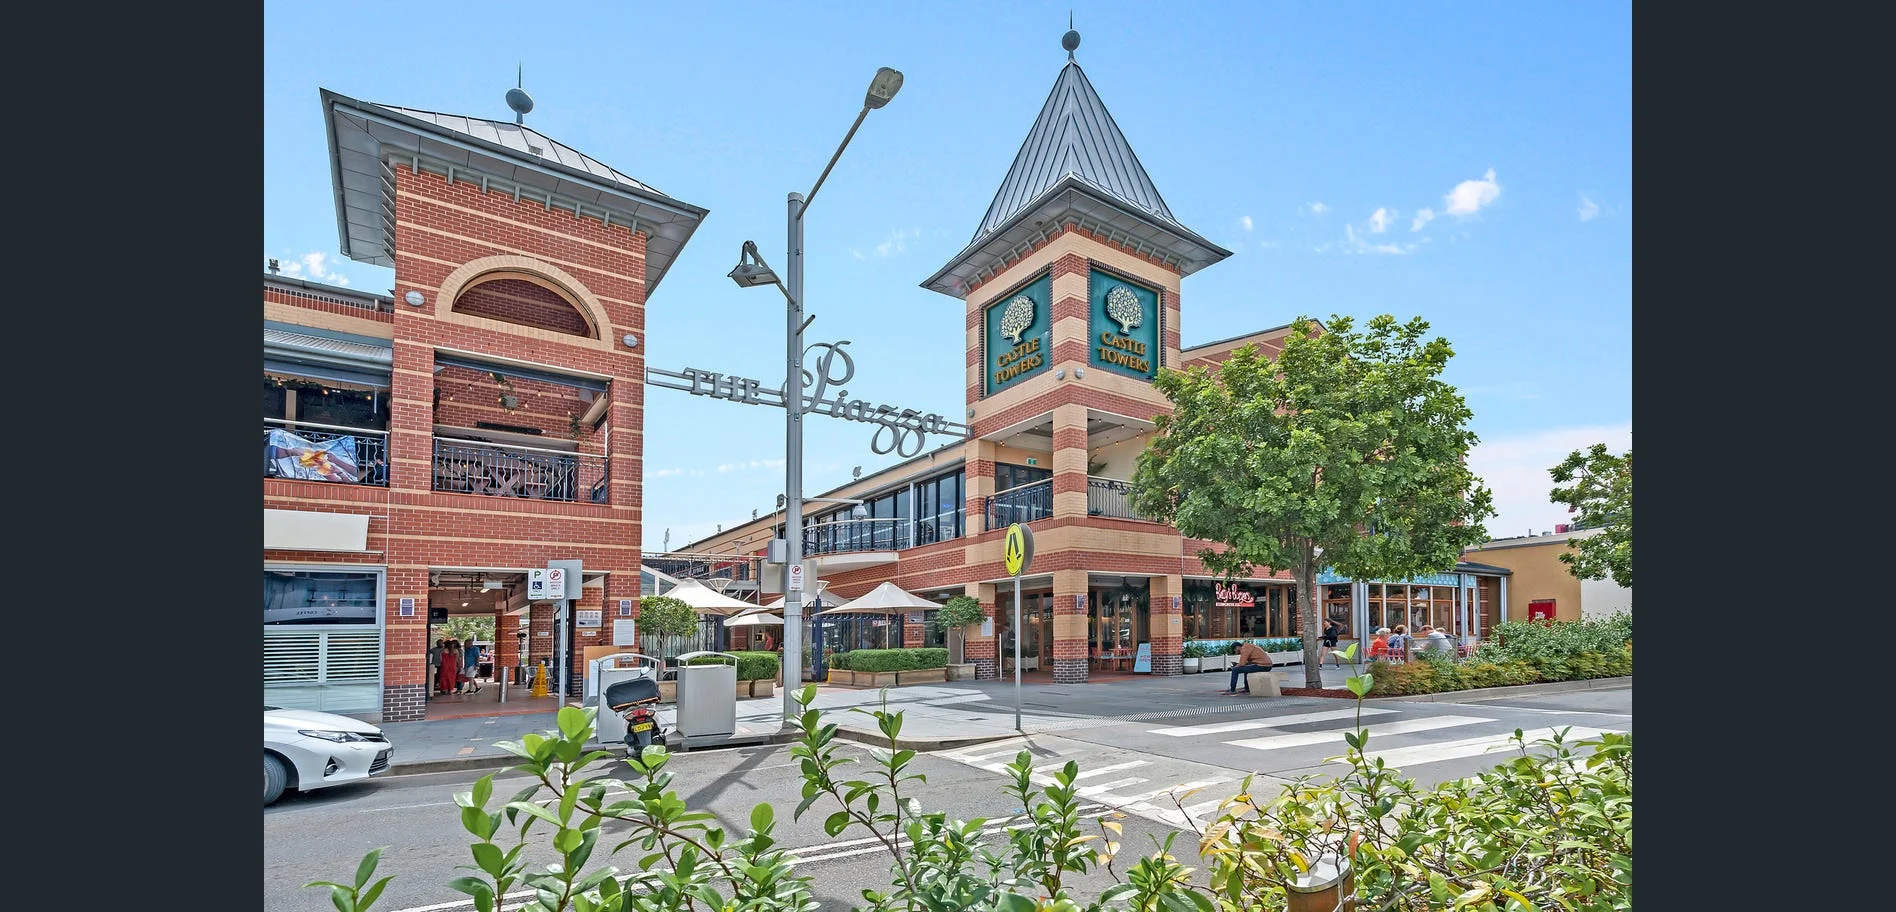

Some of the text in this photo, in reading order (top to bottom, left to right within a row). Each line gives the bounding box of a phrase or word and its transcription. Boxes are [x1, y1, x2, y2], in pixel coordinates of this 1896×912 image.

[997, 337, 1040, 367] CASTLE
[1101, 331, 1147, 356] CASTLE
[995, 353, 1043, 384] TOWERS
[1098, 346, 1150, 373] TOWERS
[683, 340, 950, 459] THE Piazza
